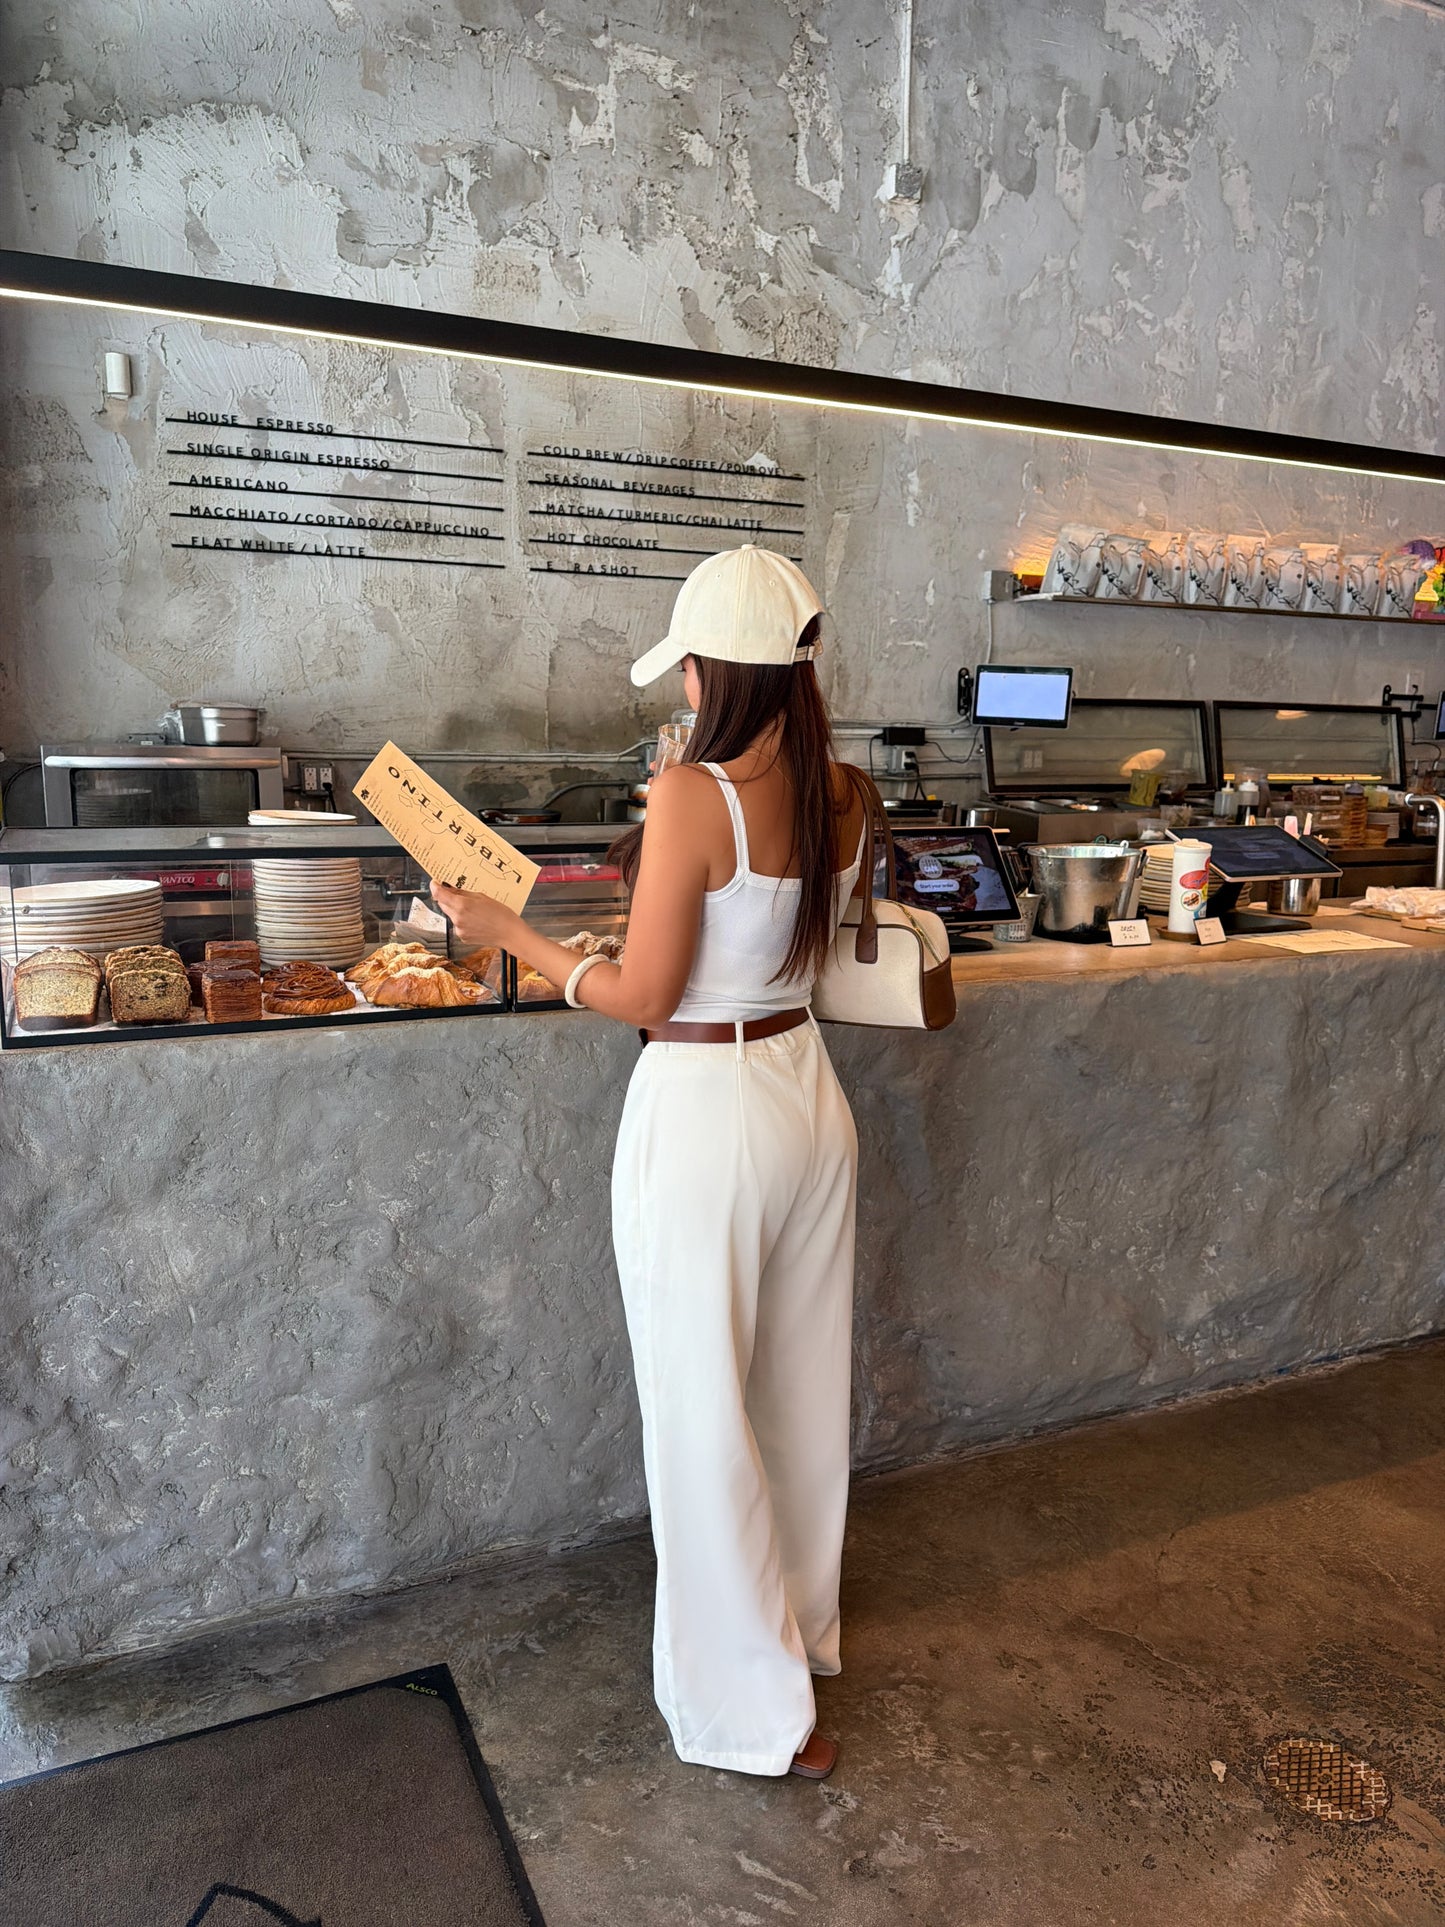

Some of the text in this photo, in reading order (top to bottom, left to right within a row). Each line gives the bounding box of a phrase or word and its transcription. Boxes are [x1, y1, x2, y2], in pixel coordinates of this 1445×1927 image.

[187, 410, 333, 434] HOUSE ESPRESSO
[187, 442, 390, 470] SINGLE ORIGIN ESPRESSO
[543, 445, 580, 458] COLD
[189, 474, 289, 492] AMERICANO
[545, 473, 695, 496] SEASONAL BEVERAGES
[191, 536, 232, 548] FLAT
[548, 532, 659, 549] HOT CHOCOLATE
[388, 766, 522, 884] LIBERTINO
[405, 1682, 438, 1696] ALSCO
